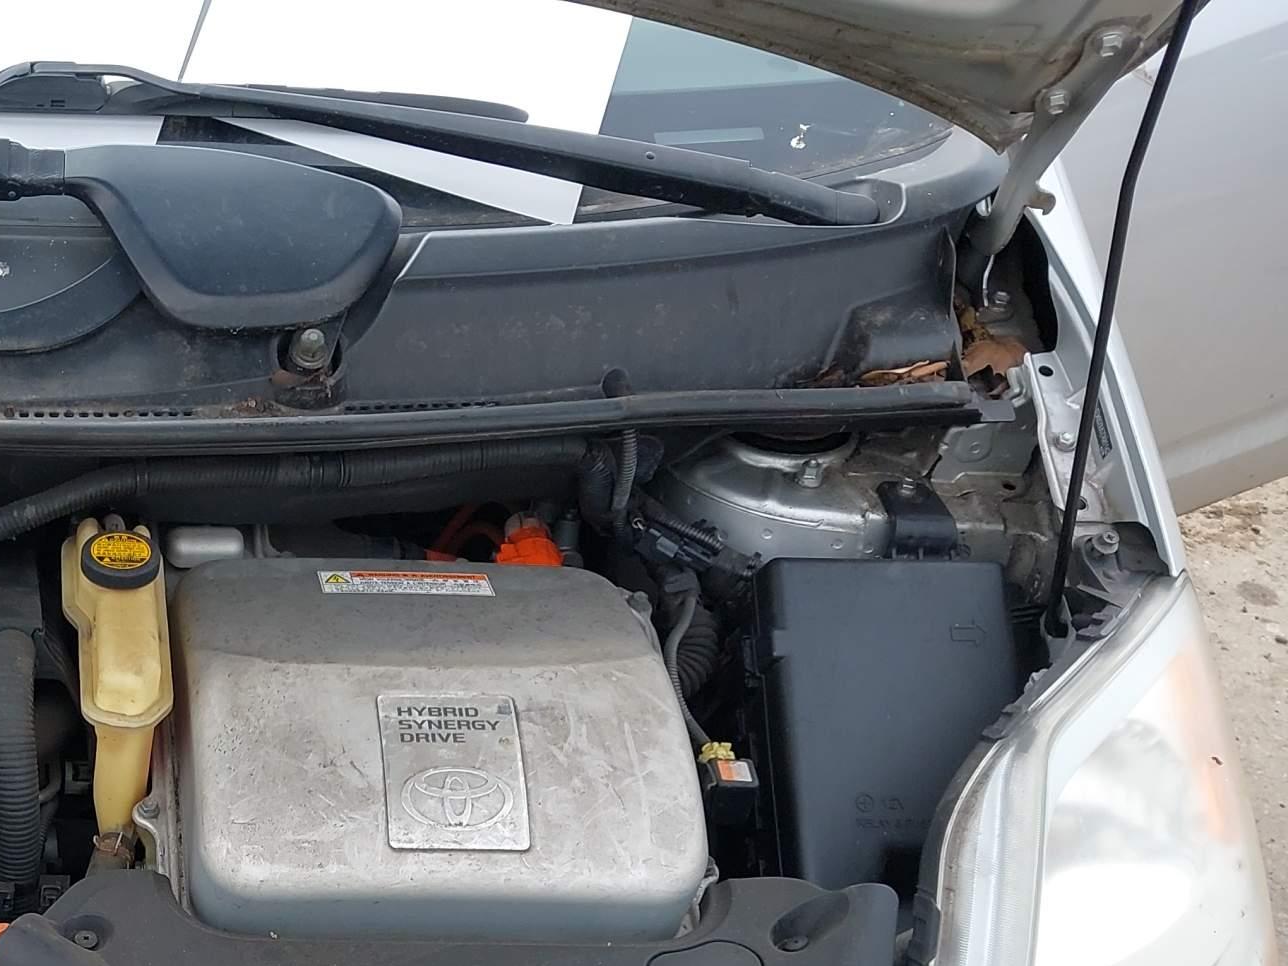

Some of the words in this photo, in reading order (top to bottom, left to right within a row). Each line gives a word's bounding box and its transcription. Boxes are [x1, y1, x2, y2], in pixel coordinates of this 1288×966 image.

[397, 706, 479, 718] HYBRID
[398, 719, 500, 731] SYNERGY
[400, 732, 466, 744] DRIVE
